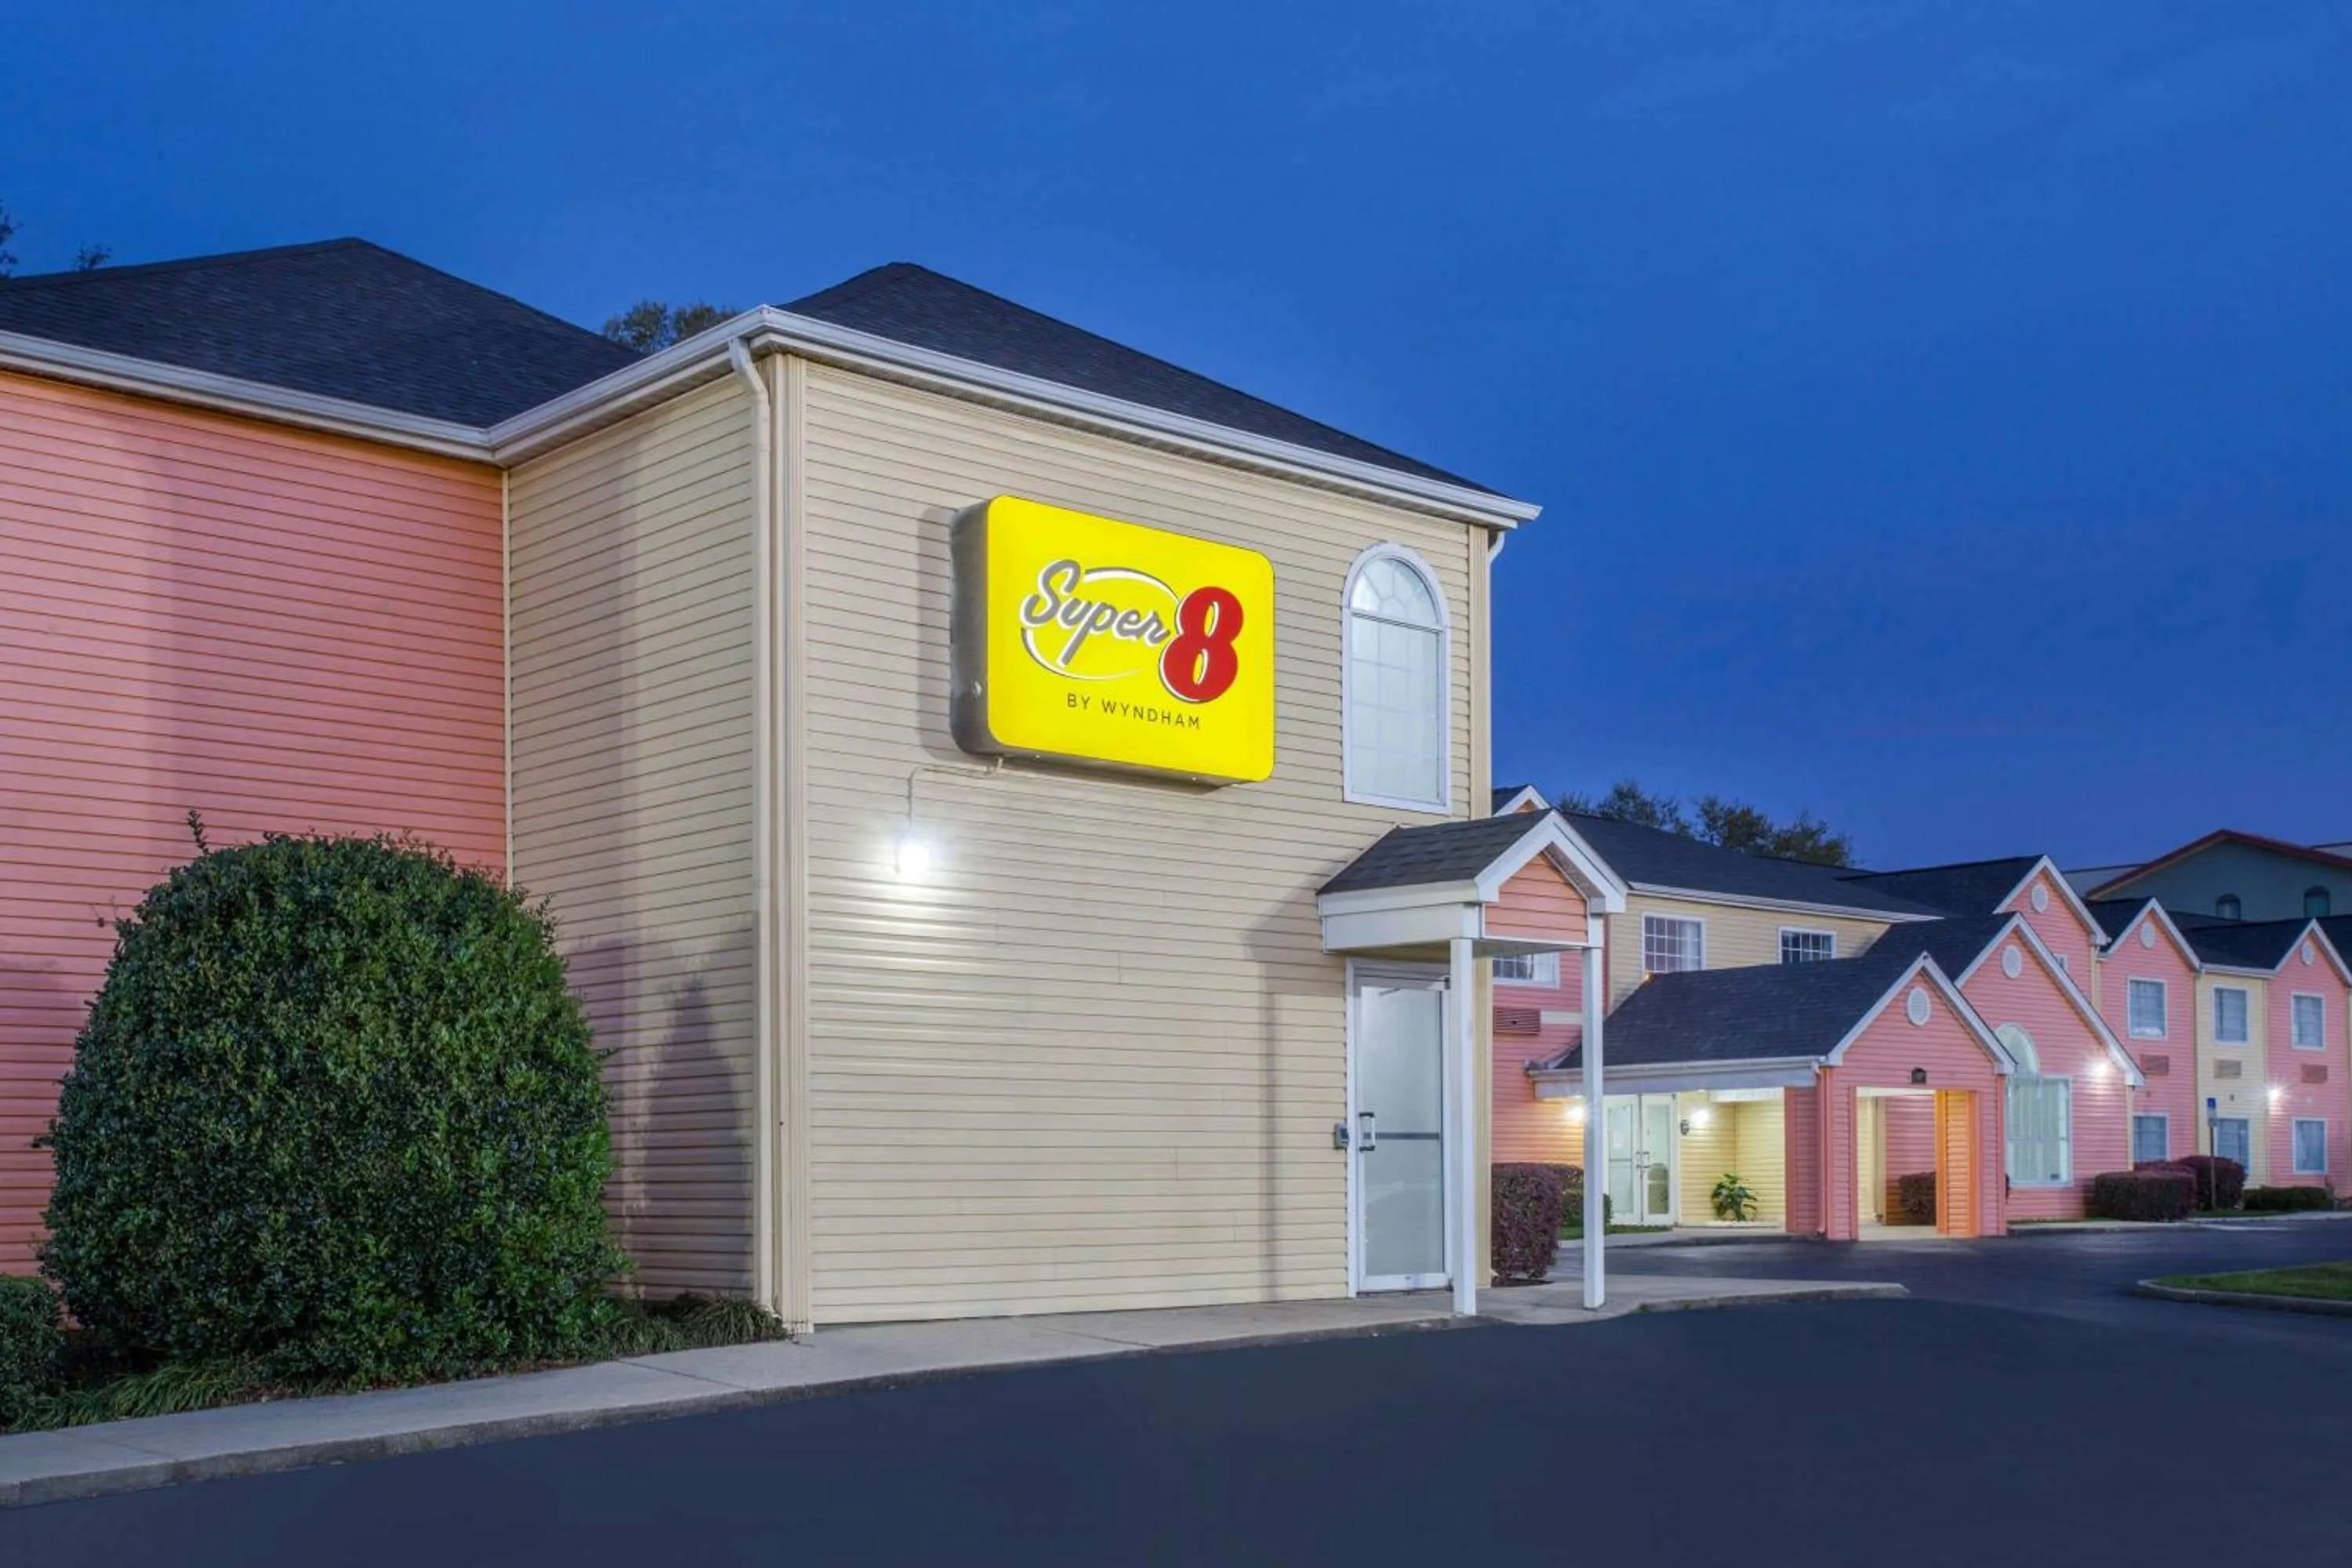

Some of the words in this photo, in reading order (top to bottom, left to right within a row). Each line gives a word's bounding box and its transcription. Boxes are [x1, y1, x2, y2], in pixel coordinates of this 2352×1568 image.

[1020, 559, 1171, 667] Super
[1160, 586, 1244, 703] 8
[1067, 693, 1091, 710] BY
[1102, 699, 1200, 729] WYNDHAM
